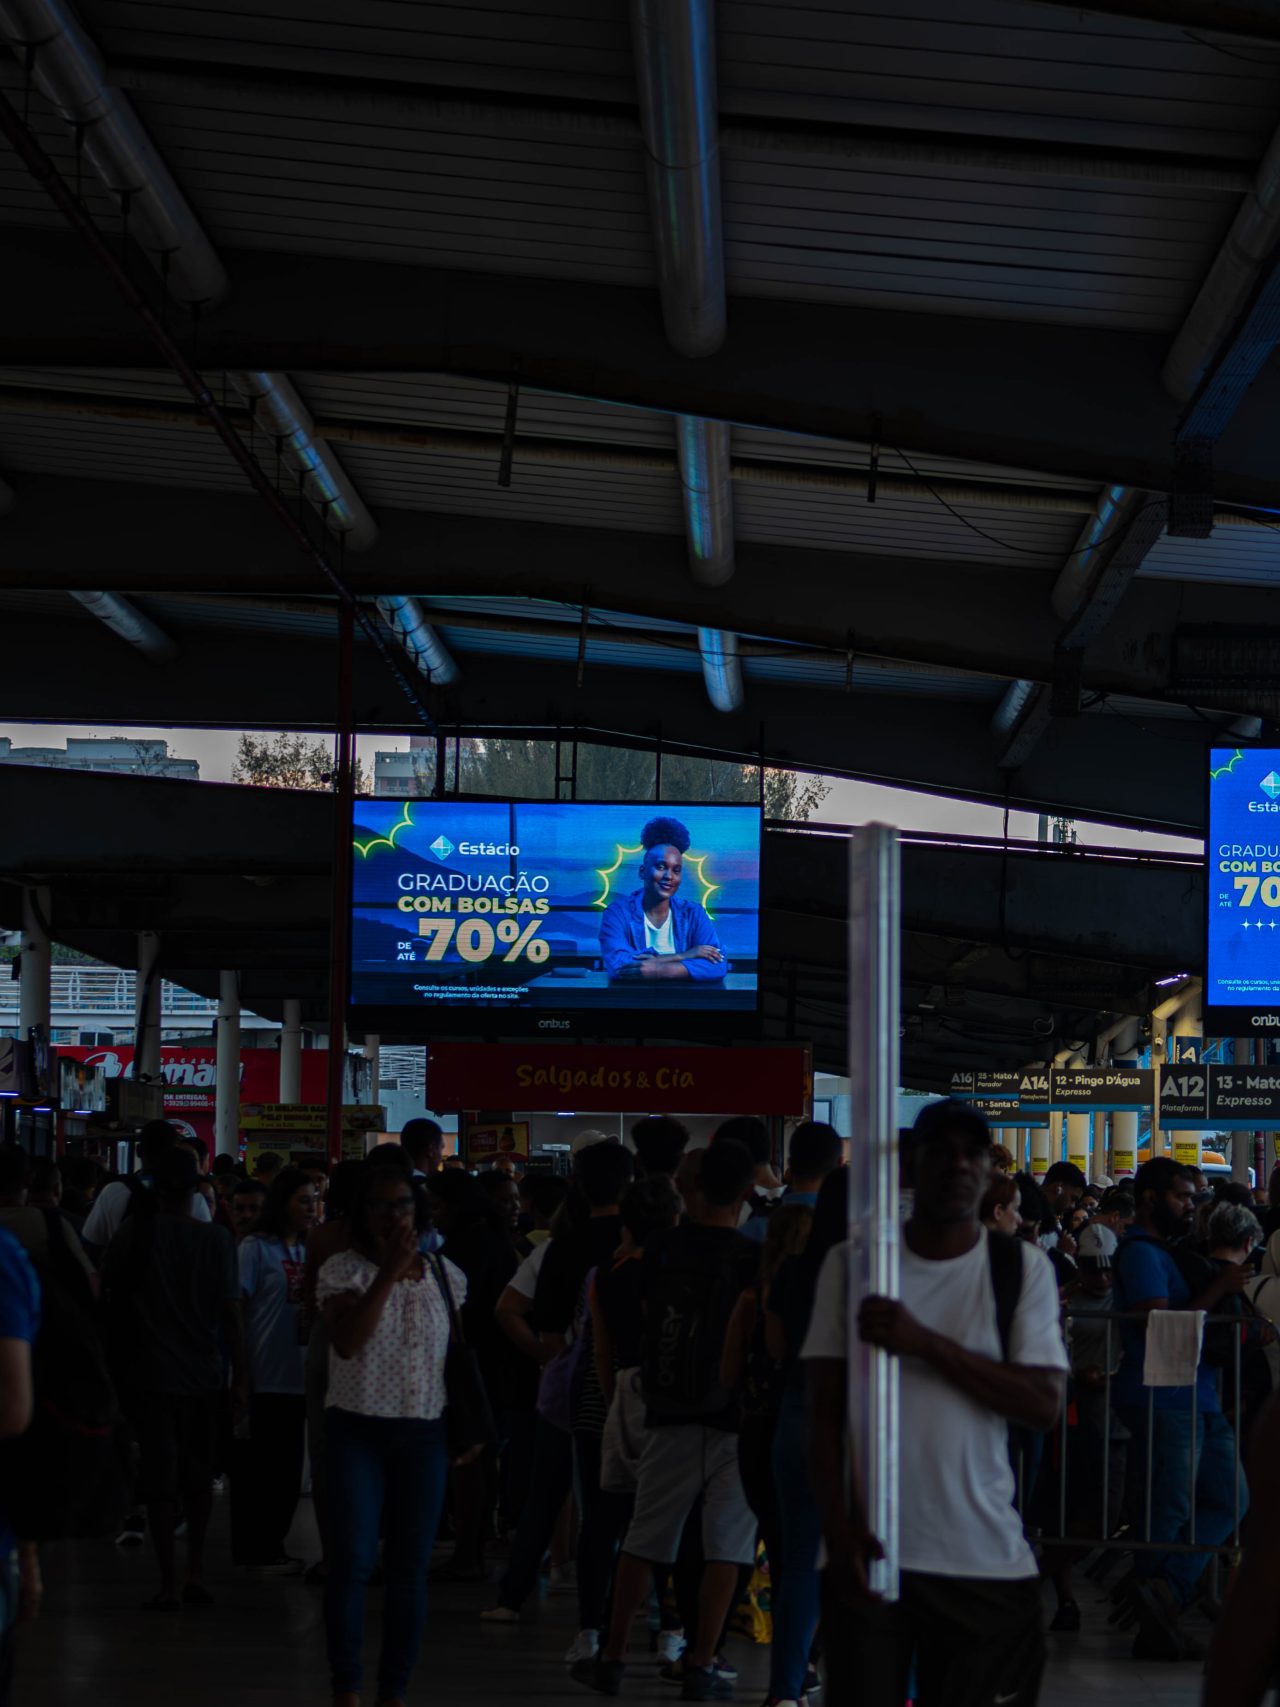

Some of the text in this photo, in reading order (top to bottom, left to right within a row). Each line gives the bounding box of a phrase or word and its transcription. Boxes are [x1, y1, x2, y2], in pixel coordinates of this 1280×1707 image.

[459, 842, 519, 855] Estácio
[1220, 861, 1256, 872] COM
[398, 872, 549, 896] GRADUAÇÃO
[398, 896, 549, 914] COM BOLSAS
[419, 918, 549, 963] 70%
[397, 952, 415, 960] ATÉ
[539, 1019, 570, 1028] onbus
[515, 1063, 695, 1094] Salgados & Cia
[951, 1072, 973, 1083] A16
[993, 1072, 1012, 1080] Mato
[1020, 1075, 1049, 1090] A14
[1055, 1076, 1067, 1085] 12
[1075, 1075, 1104, 1087] Pingo
[1106, 1073, 1141, 1087] D'Água
[1056, 1088, 1092, 1096] Expresso
[1160, 1076, 1205, 1097] A12
[1216, 1076, 1233, 1089] 13
[1161, 1094, 1272, 1113] Plataforma Expresso
